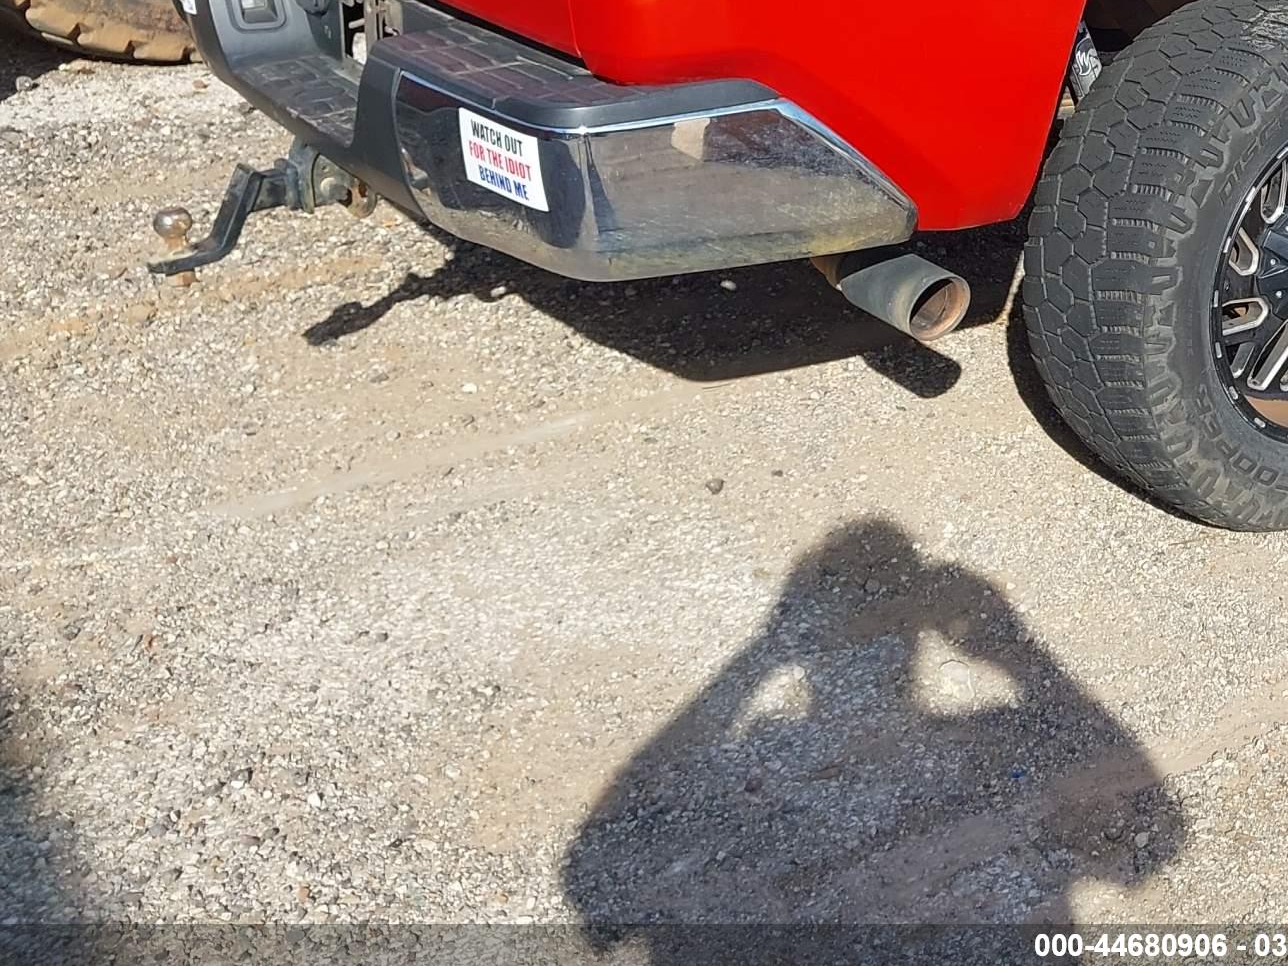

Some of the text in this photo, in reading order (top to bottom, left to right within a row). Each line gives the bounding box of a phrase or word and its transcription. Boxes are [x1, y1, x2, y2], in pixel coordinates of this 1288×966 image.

[470, 118, 523, 156] WATCH OUT
[469, 140, 532, 182] FOR THE IDIOT
[478, 164, 530, 201] BEHIND ME
